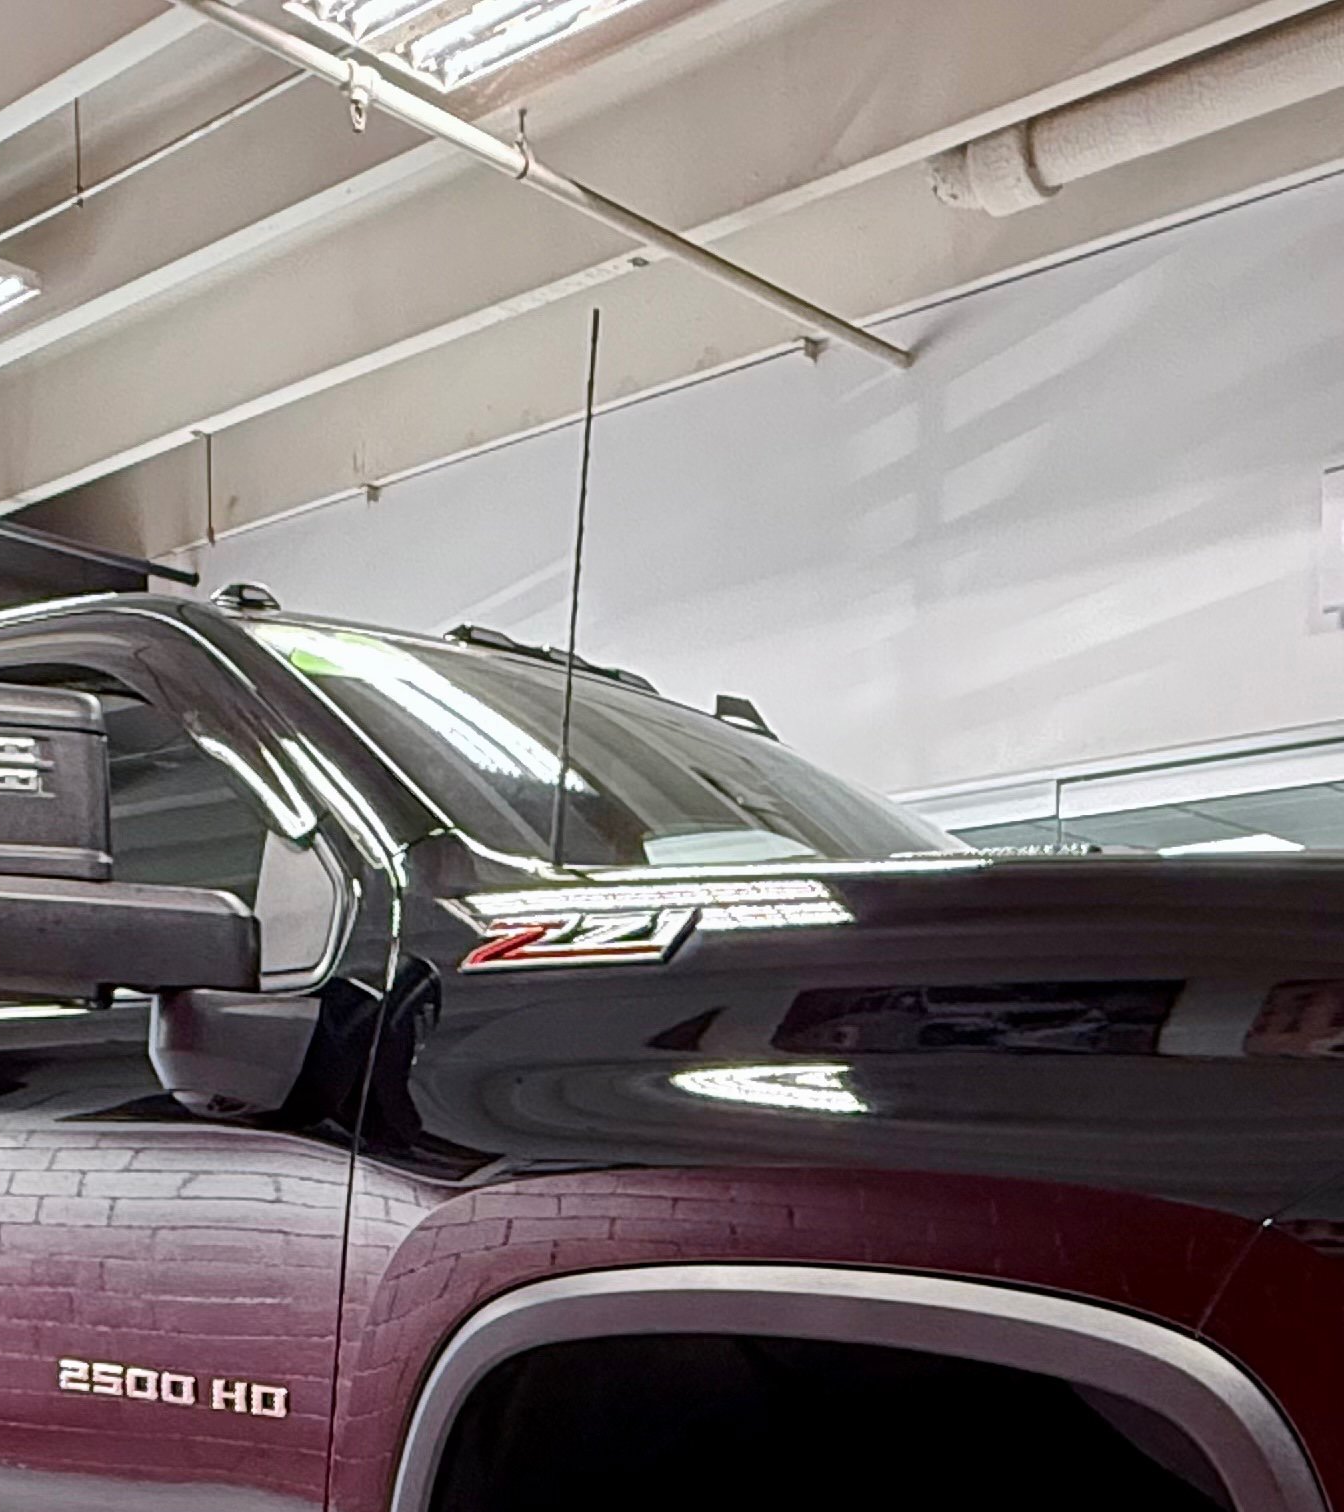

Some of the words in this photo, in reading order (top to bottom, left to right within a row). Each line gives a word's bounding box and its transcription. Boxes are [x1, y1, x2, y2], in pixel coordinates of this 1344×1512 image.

[458, 906, 702, 973] Z71
[58, 1359, 196, 1405] 2500
[211, 1378, 288, 1418] HD
